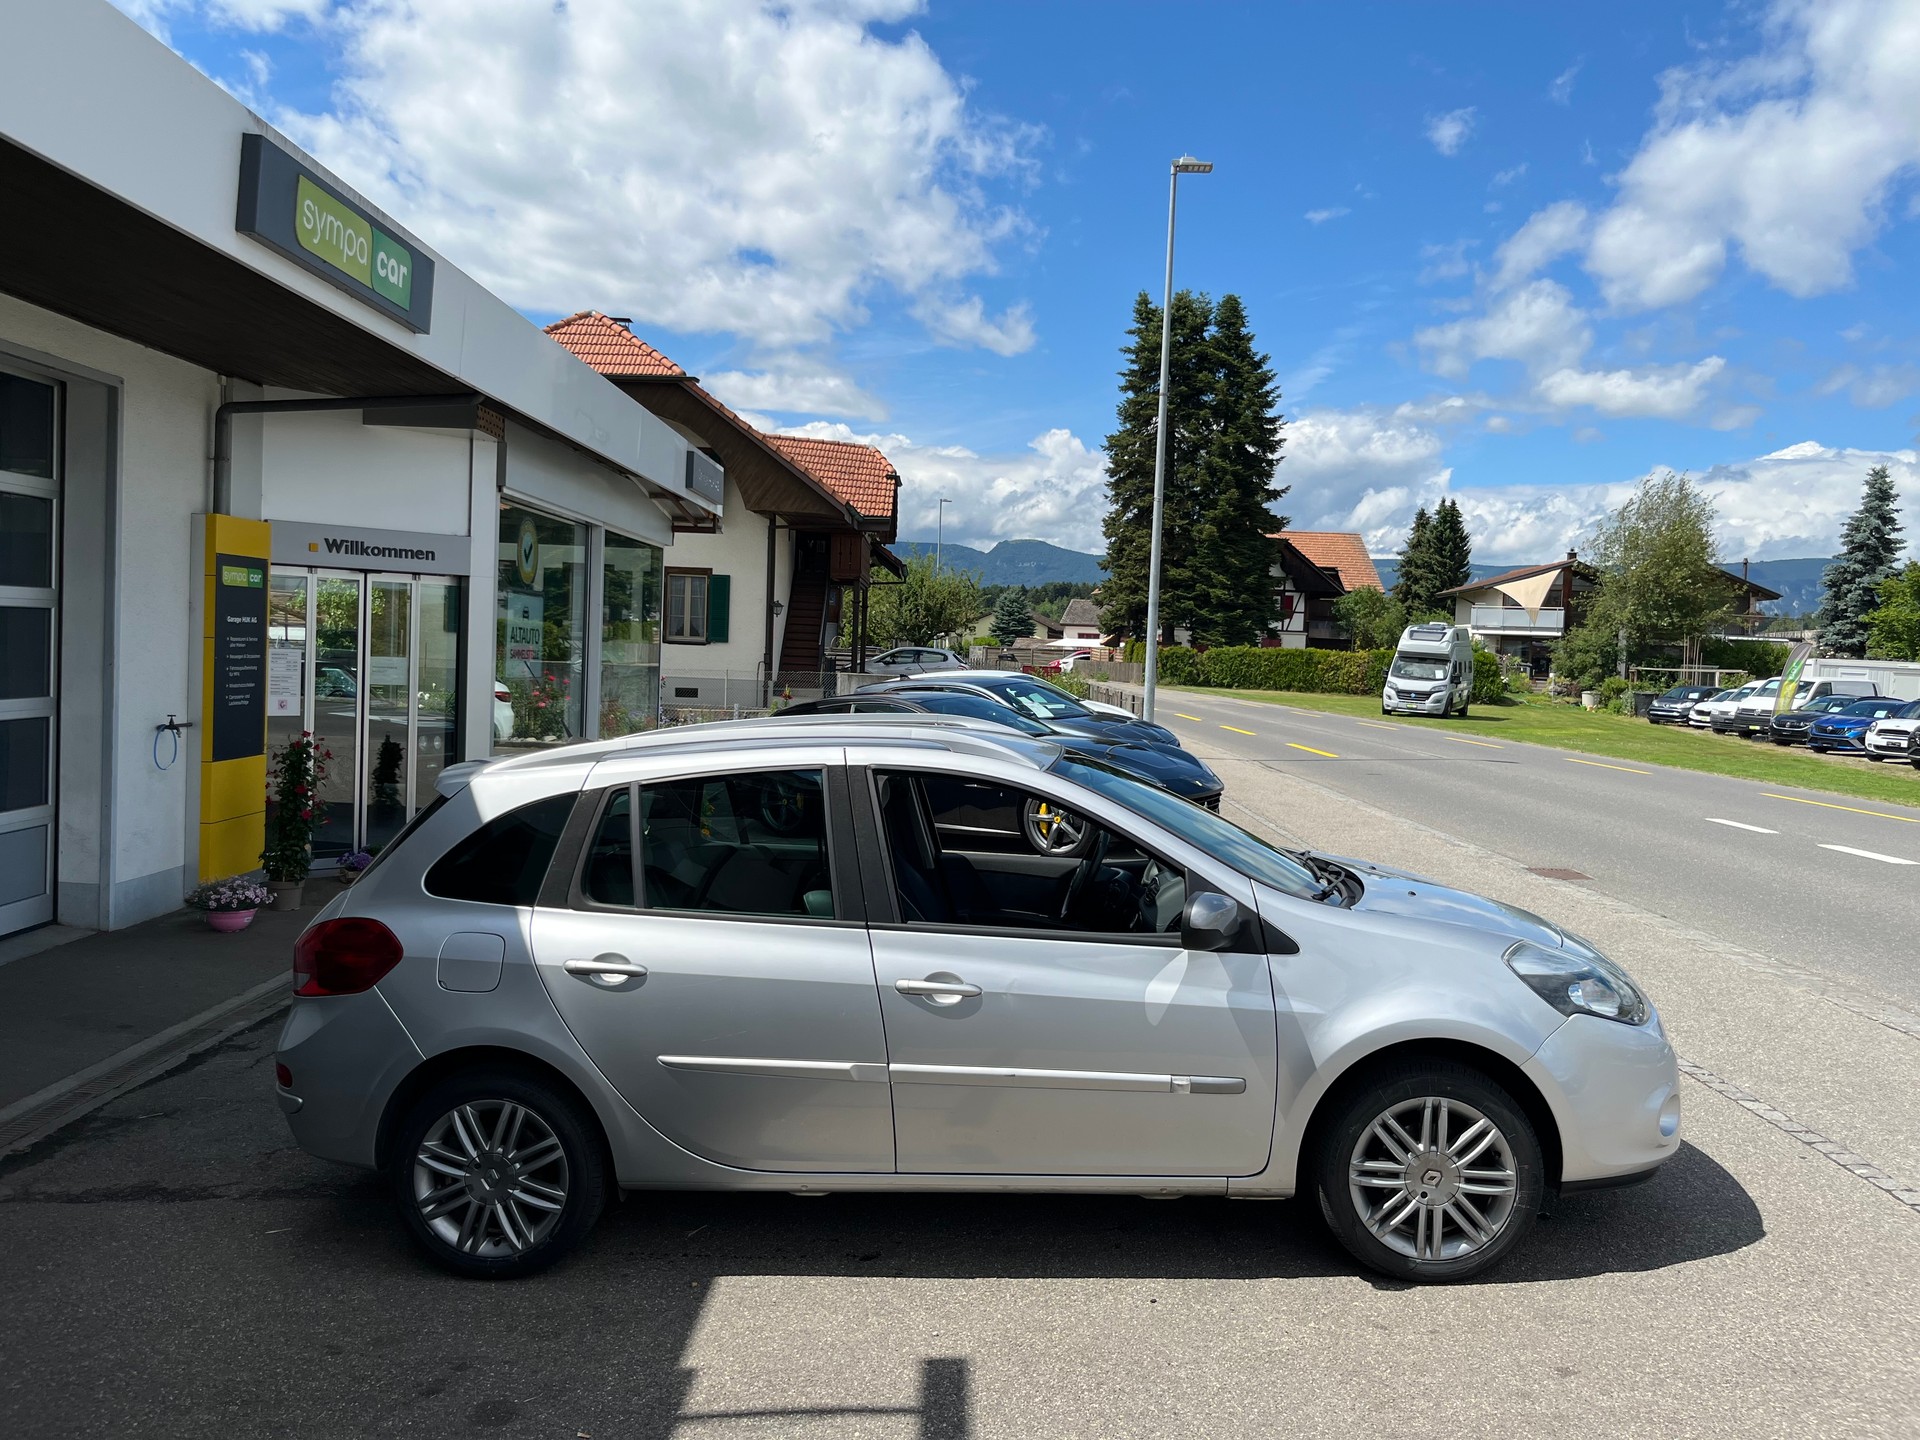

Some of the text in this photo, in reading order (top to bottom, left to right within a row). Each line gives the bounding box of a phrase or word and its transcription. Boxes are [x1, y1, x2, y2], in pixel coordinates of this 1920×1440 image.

[303, 199, 408, 288] sympa car
[324, 538, 436, 561] Willkommen
[224, 571, 262, 583] sympa car
[227, 616, 242, 624] Garage
[510, 626, 540, 645] ALTAUTO
